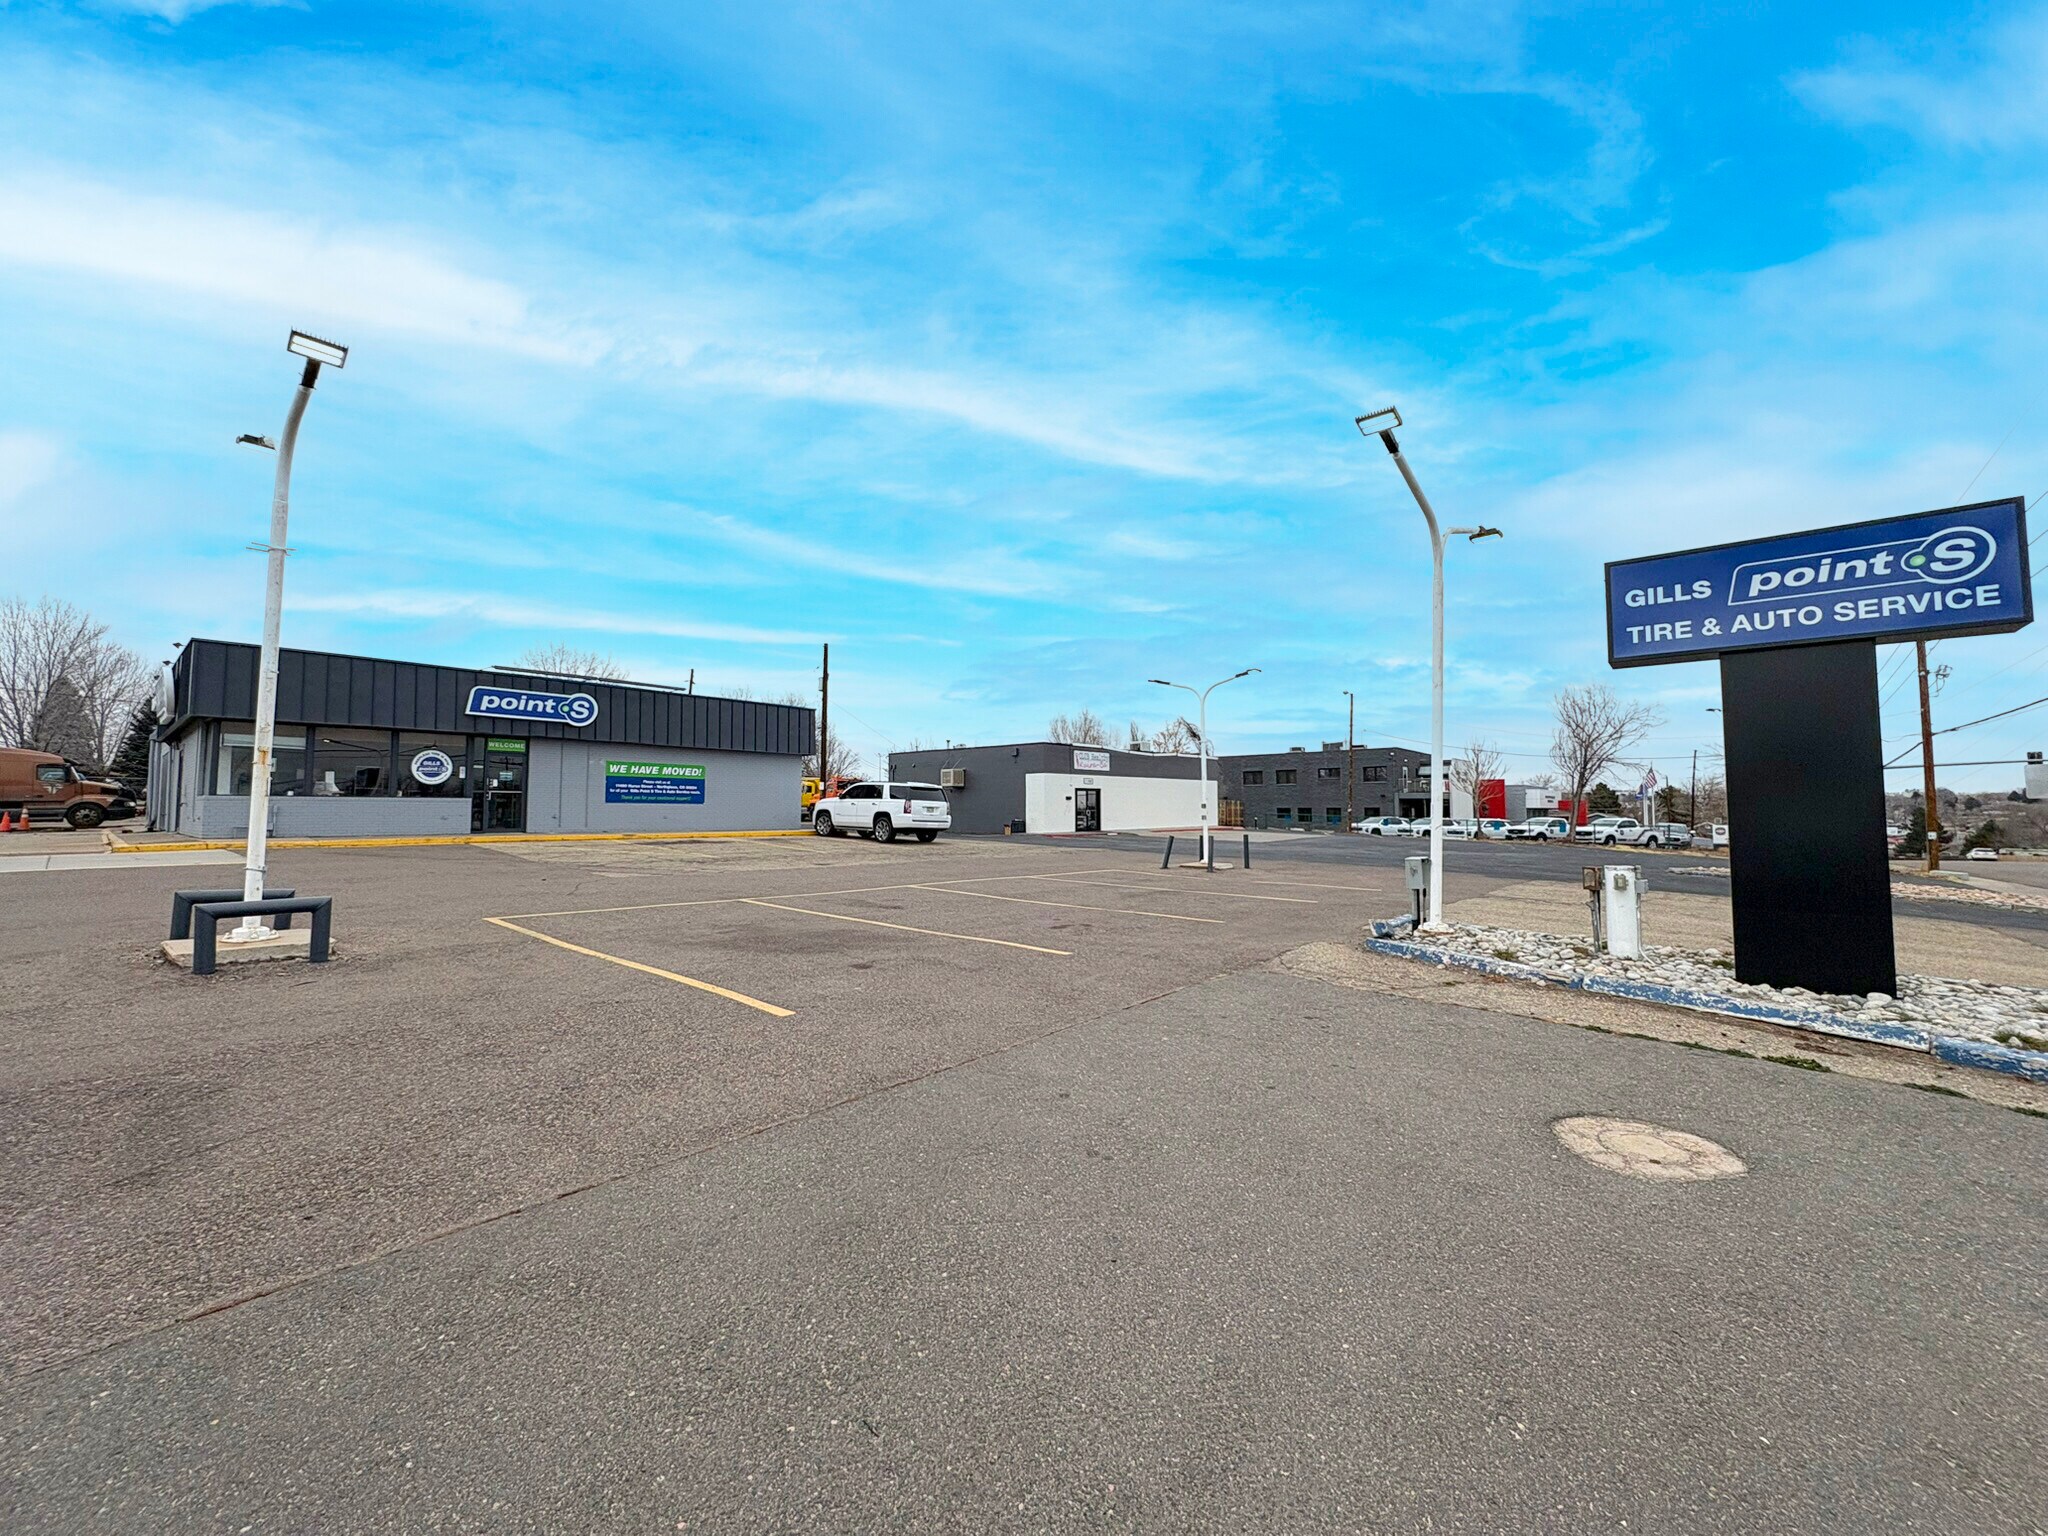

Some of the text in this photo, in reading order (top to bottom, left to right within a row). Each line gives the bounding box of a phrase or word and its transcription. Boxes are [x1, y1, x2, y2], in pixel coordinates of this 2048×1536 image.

[1748, 538, 1976, 598] point S
[1624, 579, 1712, 608] GILLS
[1626, 583, 2001, 644] TIRE & AUTO SERVICE
[479, 694, 590, 719] point S
[488, 741, 526, 749] WELCOME
[609, 764, 702, 777] WE HAVE MOVED!
